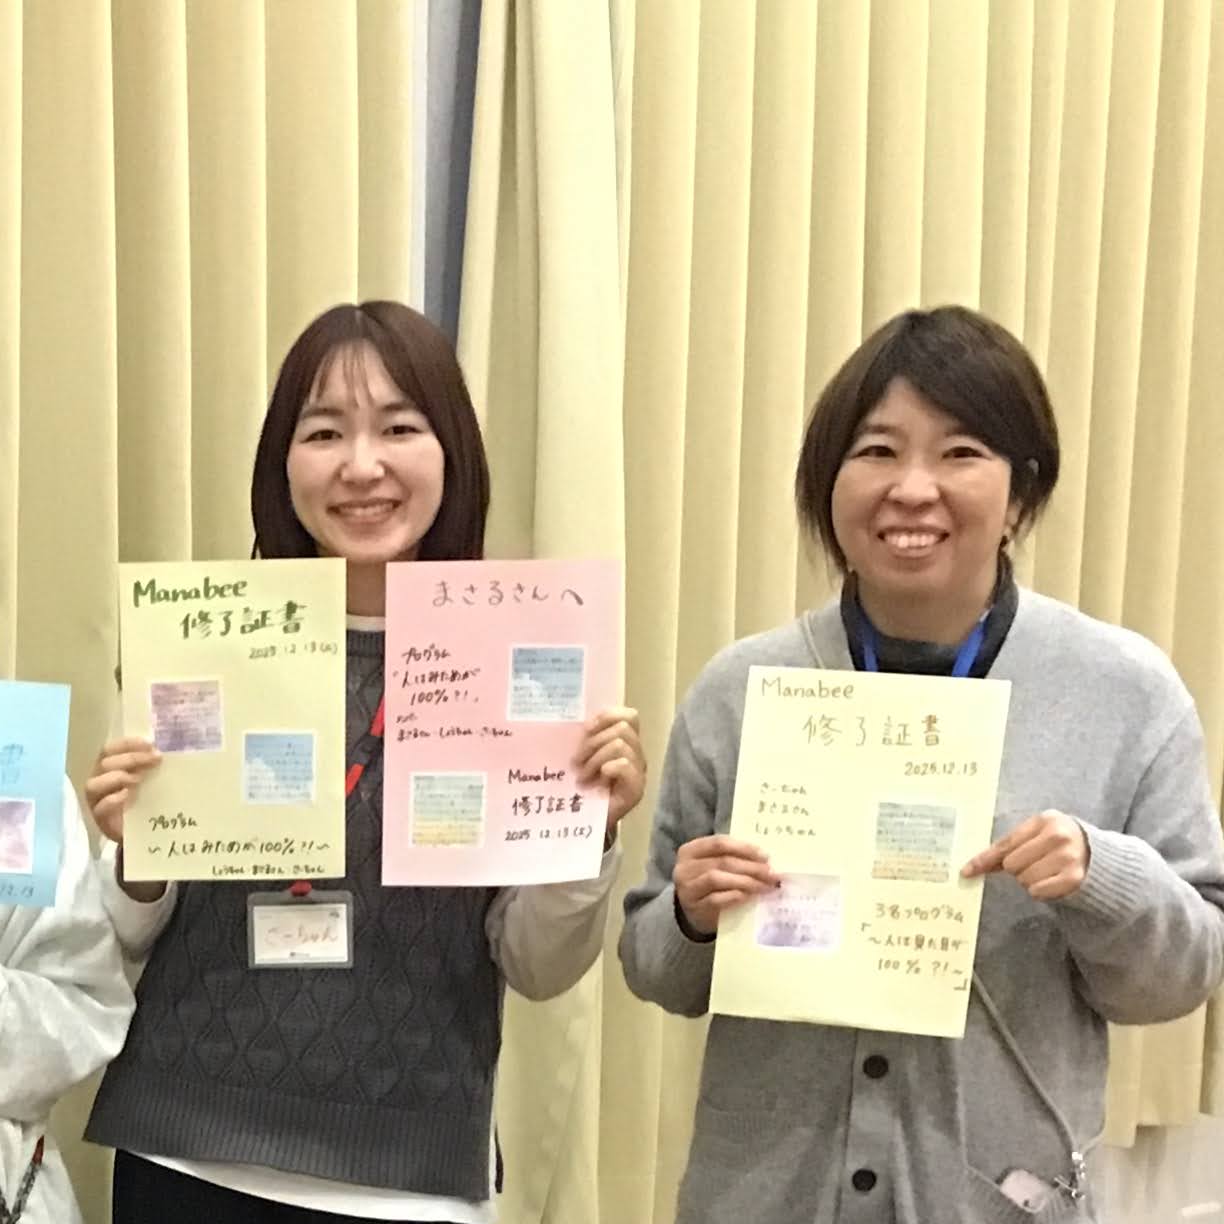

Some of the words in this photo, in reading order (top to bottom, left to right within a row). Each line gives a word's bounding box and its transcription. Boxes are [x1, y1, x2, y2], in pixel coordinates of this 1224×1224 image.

[134, 576, 248, 608] Manabee
[432, 580, 585, 607] まさるさんへ
[179, 600, 307, 639] 修了証書
[762, 676, 855, 699] Manabee
[802, 713, 942, 746] 修了証書
[508, 766, 566, 784] Manabee
[904, 761, 978, 776] 2025.12.13
[512, 793, 584, 816] 修了証書
